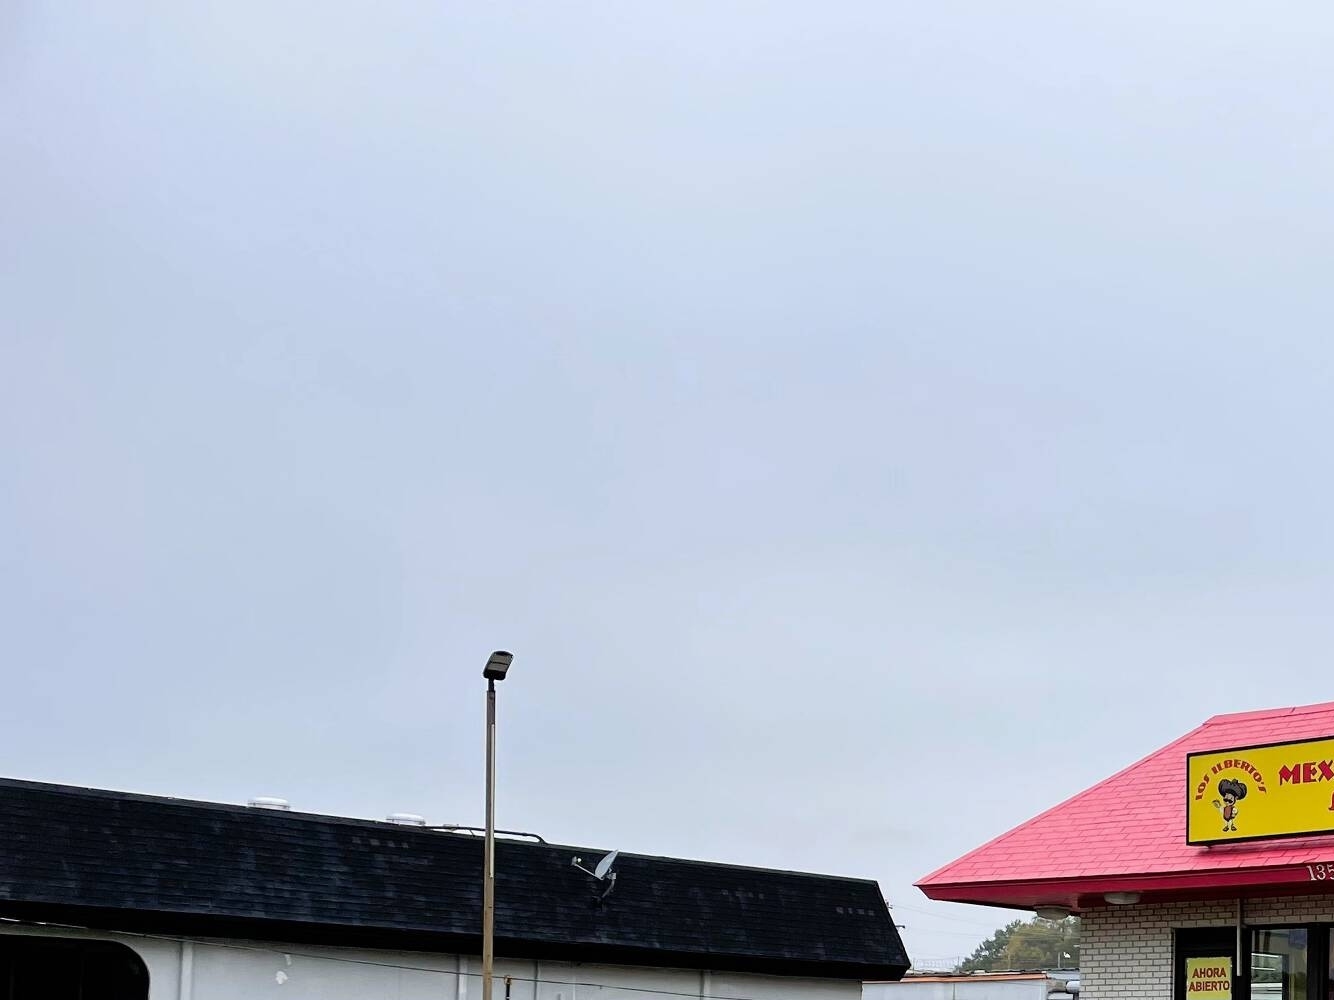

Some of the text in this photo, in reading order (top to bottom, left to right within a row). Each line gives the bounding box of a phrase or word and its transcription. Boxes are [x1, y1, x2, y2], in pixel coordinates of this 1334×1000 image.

[1195, 774, 1210, 801] LOS
[1192, 967, 1227, 978] AHORA
[1188, 980, 1230, 992] ABIERTO
